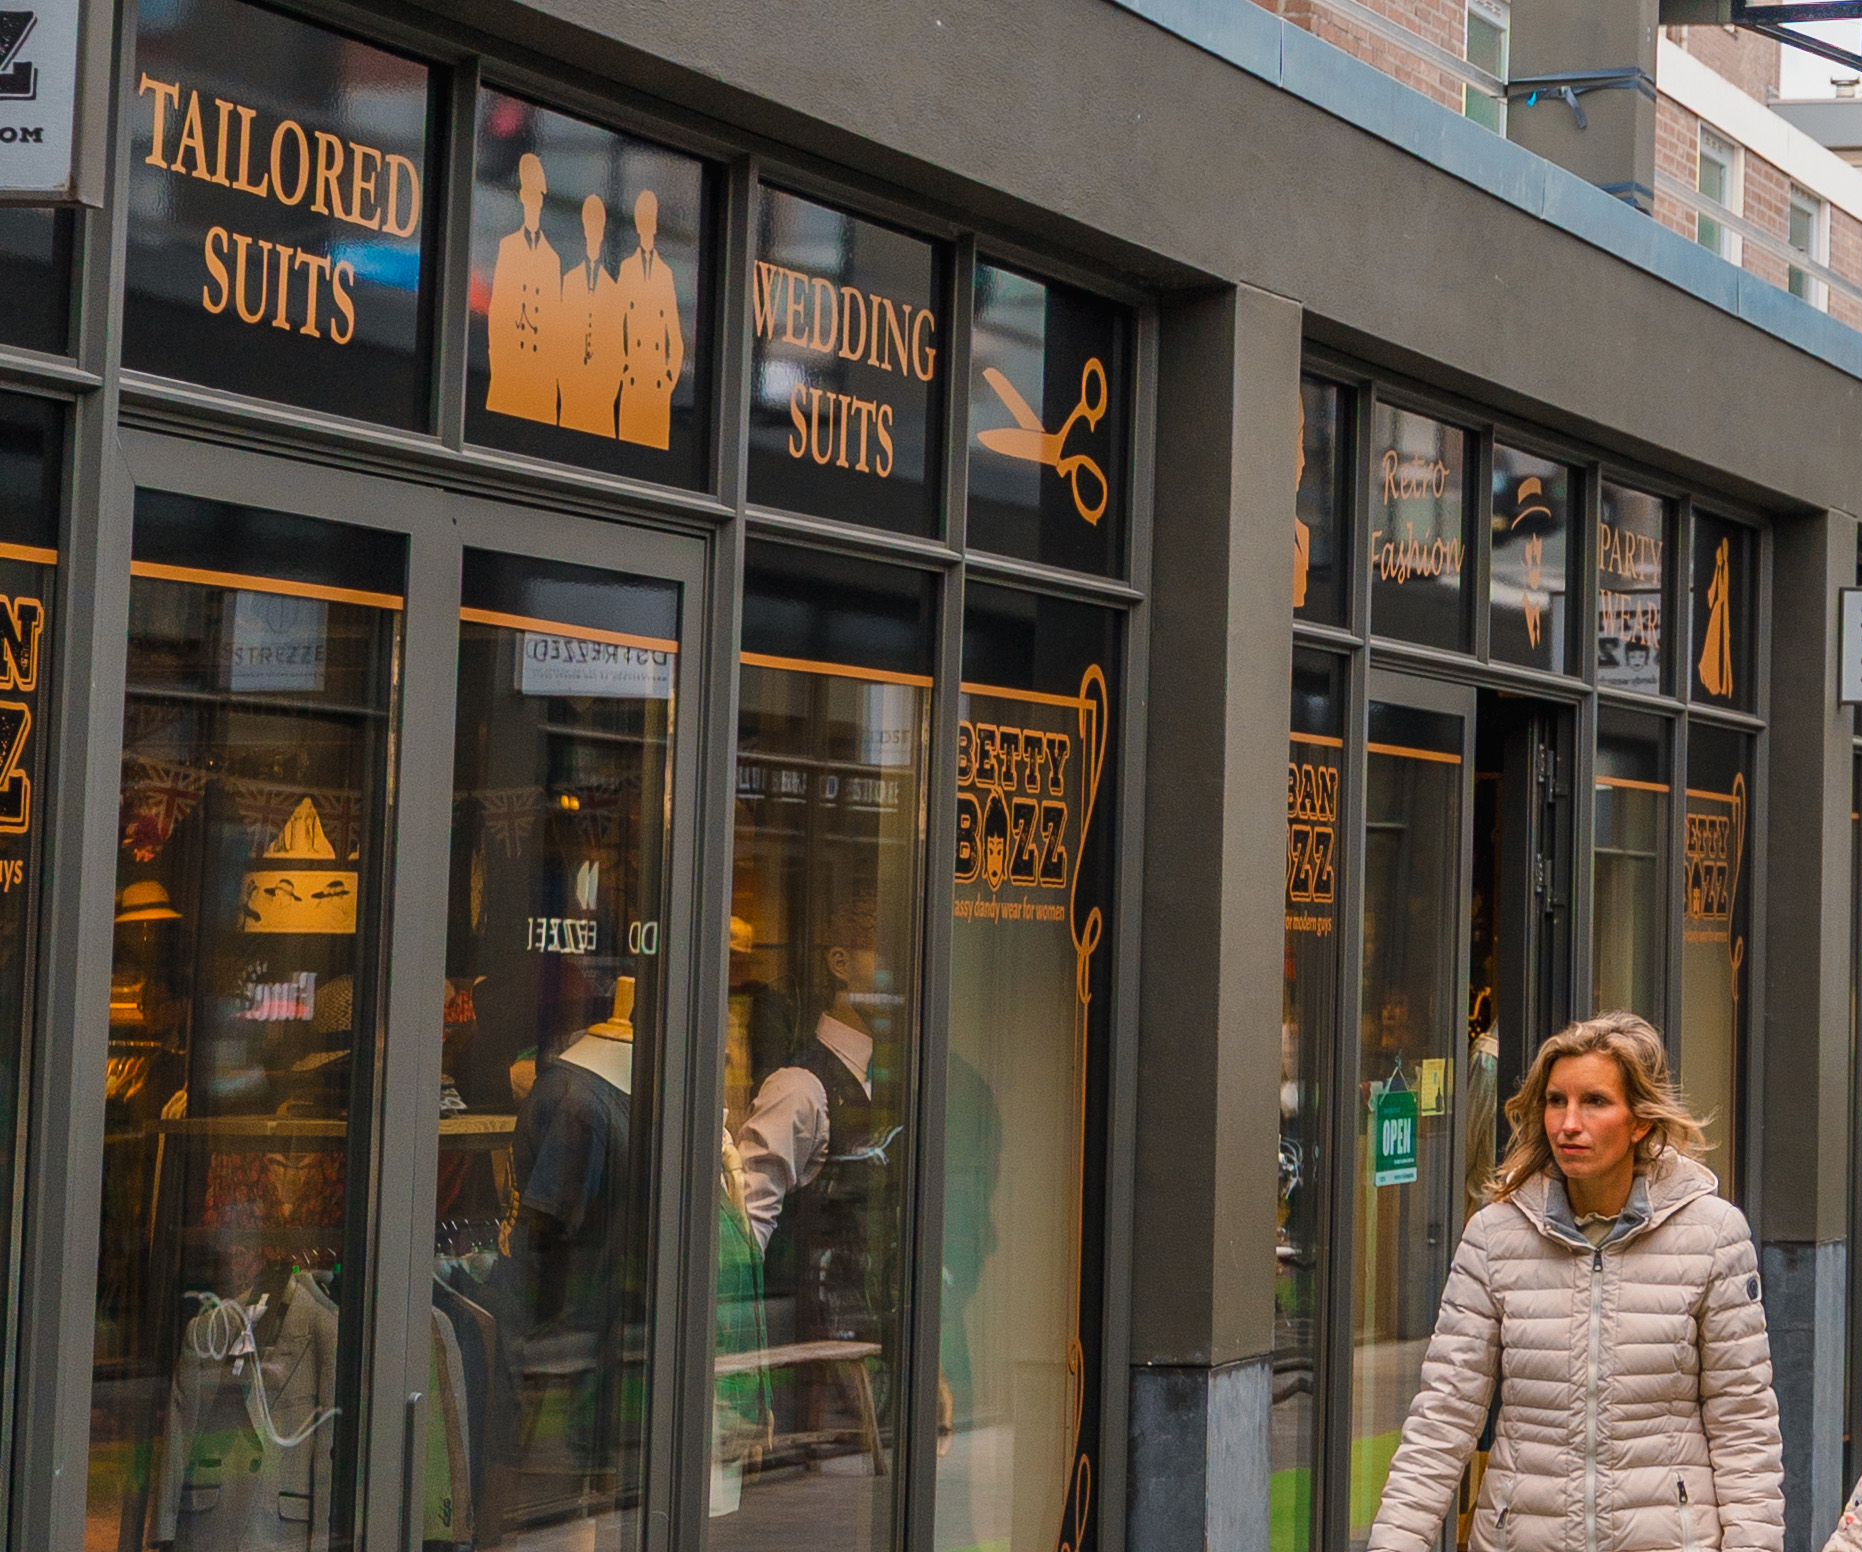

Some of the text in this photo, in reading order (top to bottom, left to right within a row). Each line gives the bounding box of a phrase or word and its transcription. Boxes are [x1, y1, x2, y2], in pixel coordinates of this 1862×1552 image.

[138, 71, 421, 239] TAILORED
[202, 225, 355, 345] SUITS
[752, 259, 936, 383] WEDDING
[788, 382, 894, 478] SUITS
[1383, 449, 1450, 506] Retro
[1371, 520, 1465, 584] Fashion
[1600, 523, 1663, 585] PARTY
[1600, 589, 1661, 649] WEAR
[957, 720, 1071, 796] BETTY
[1287, 762, 1338, 822] BAN
[1287, 824, 1335, 903] ZZ
[1686, 813, 1729, 859] ETTY
[953, 899, 973, 924] assy
[974, 893, 1000, 924] dandy
[1035, 904, 1065, 922] women
[1382, 1117, 1412, 1157] OPEN
